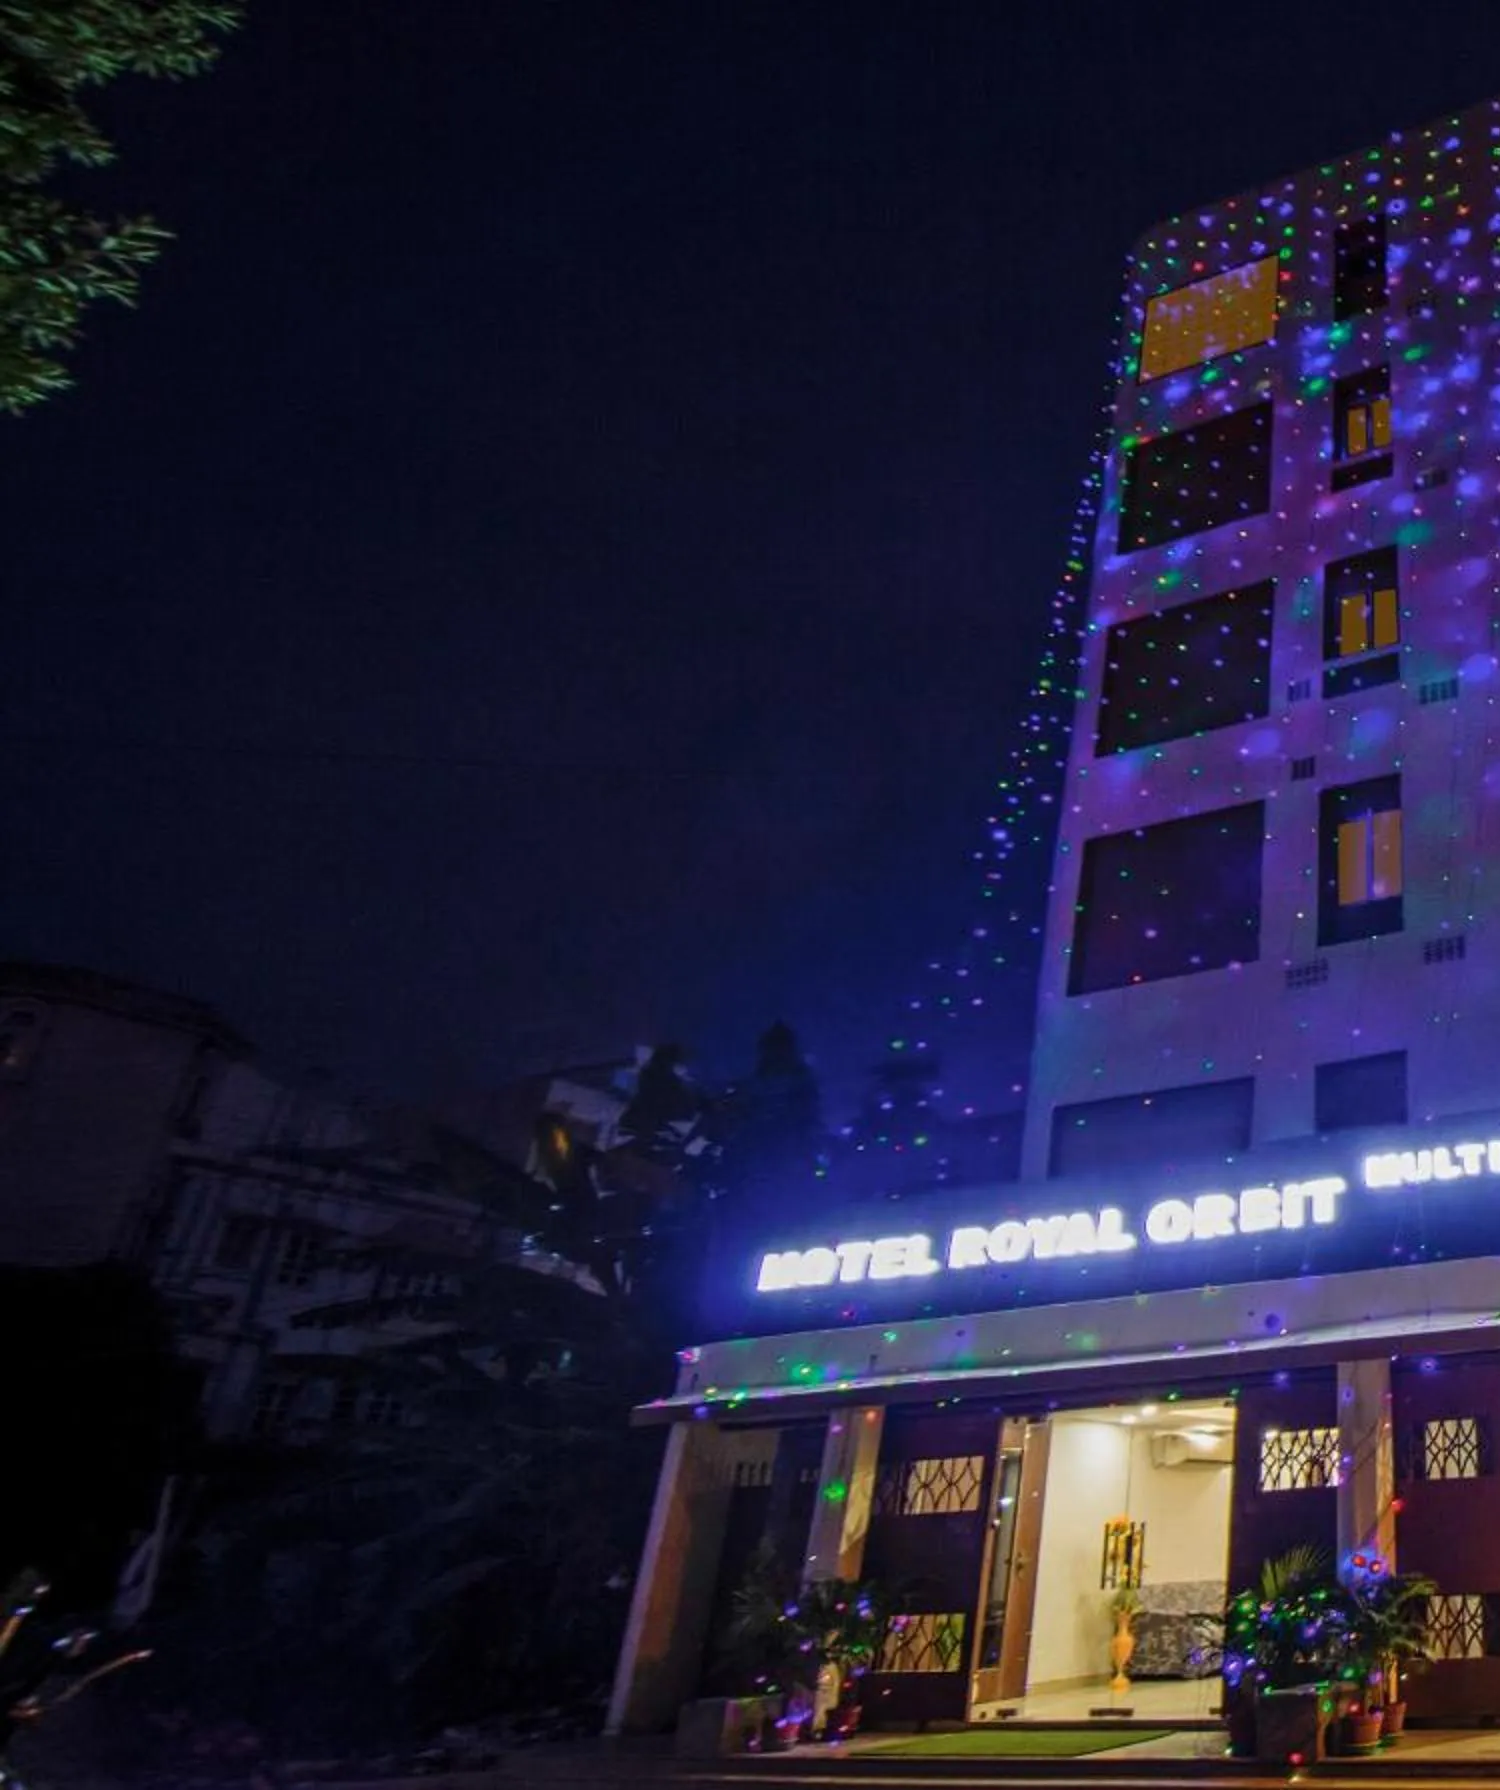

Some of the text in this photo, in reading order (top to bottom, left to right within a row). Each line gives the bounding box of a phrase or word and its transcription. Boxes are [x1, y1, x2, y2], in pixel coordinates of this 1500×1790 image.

[757, 1177, 1346, 1291] HOTEL ROYAL ORBIT
